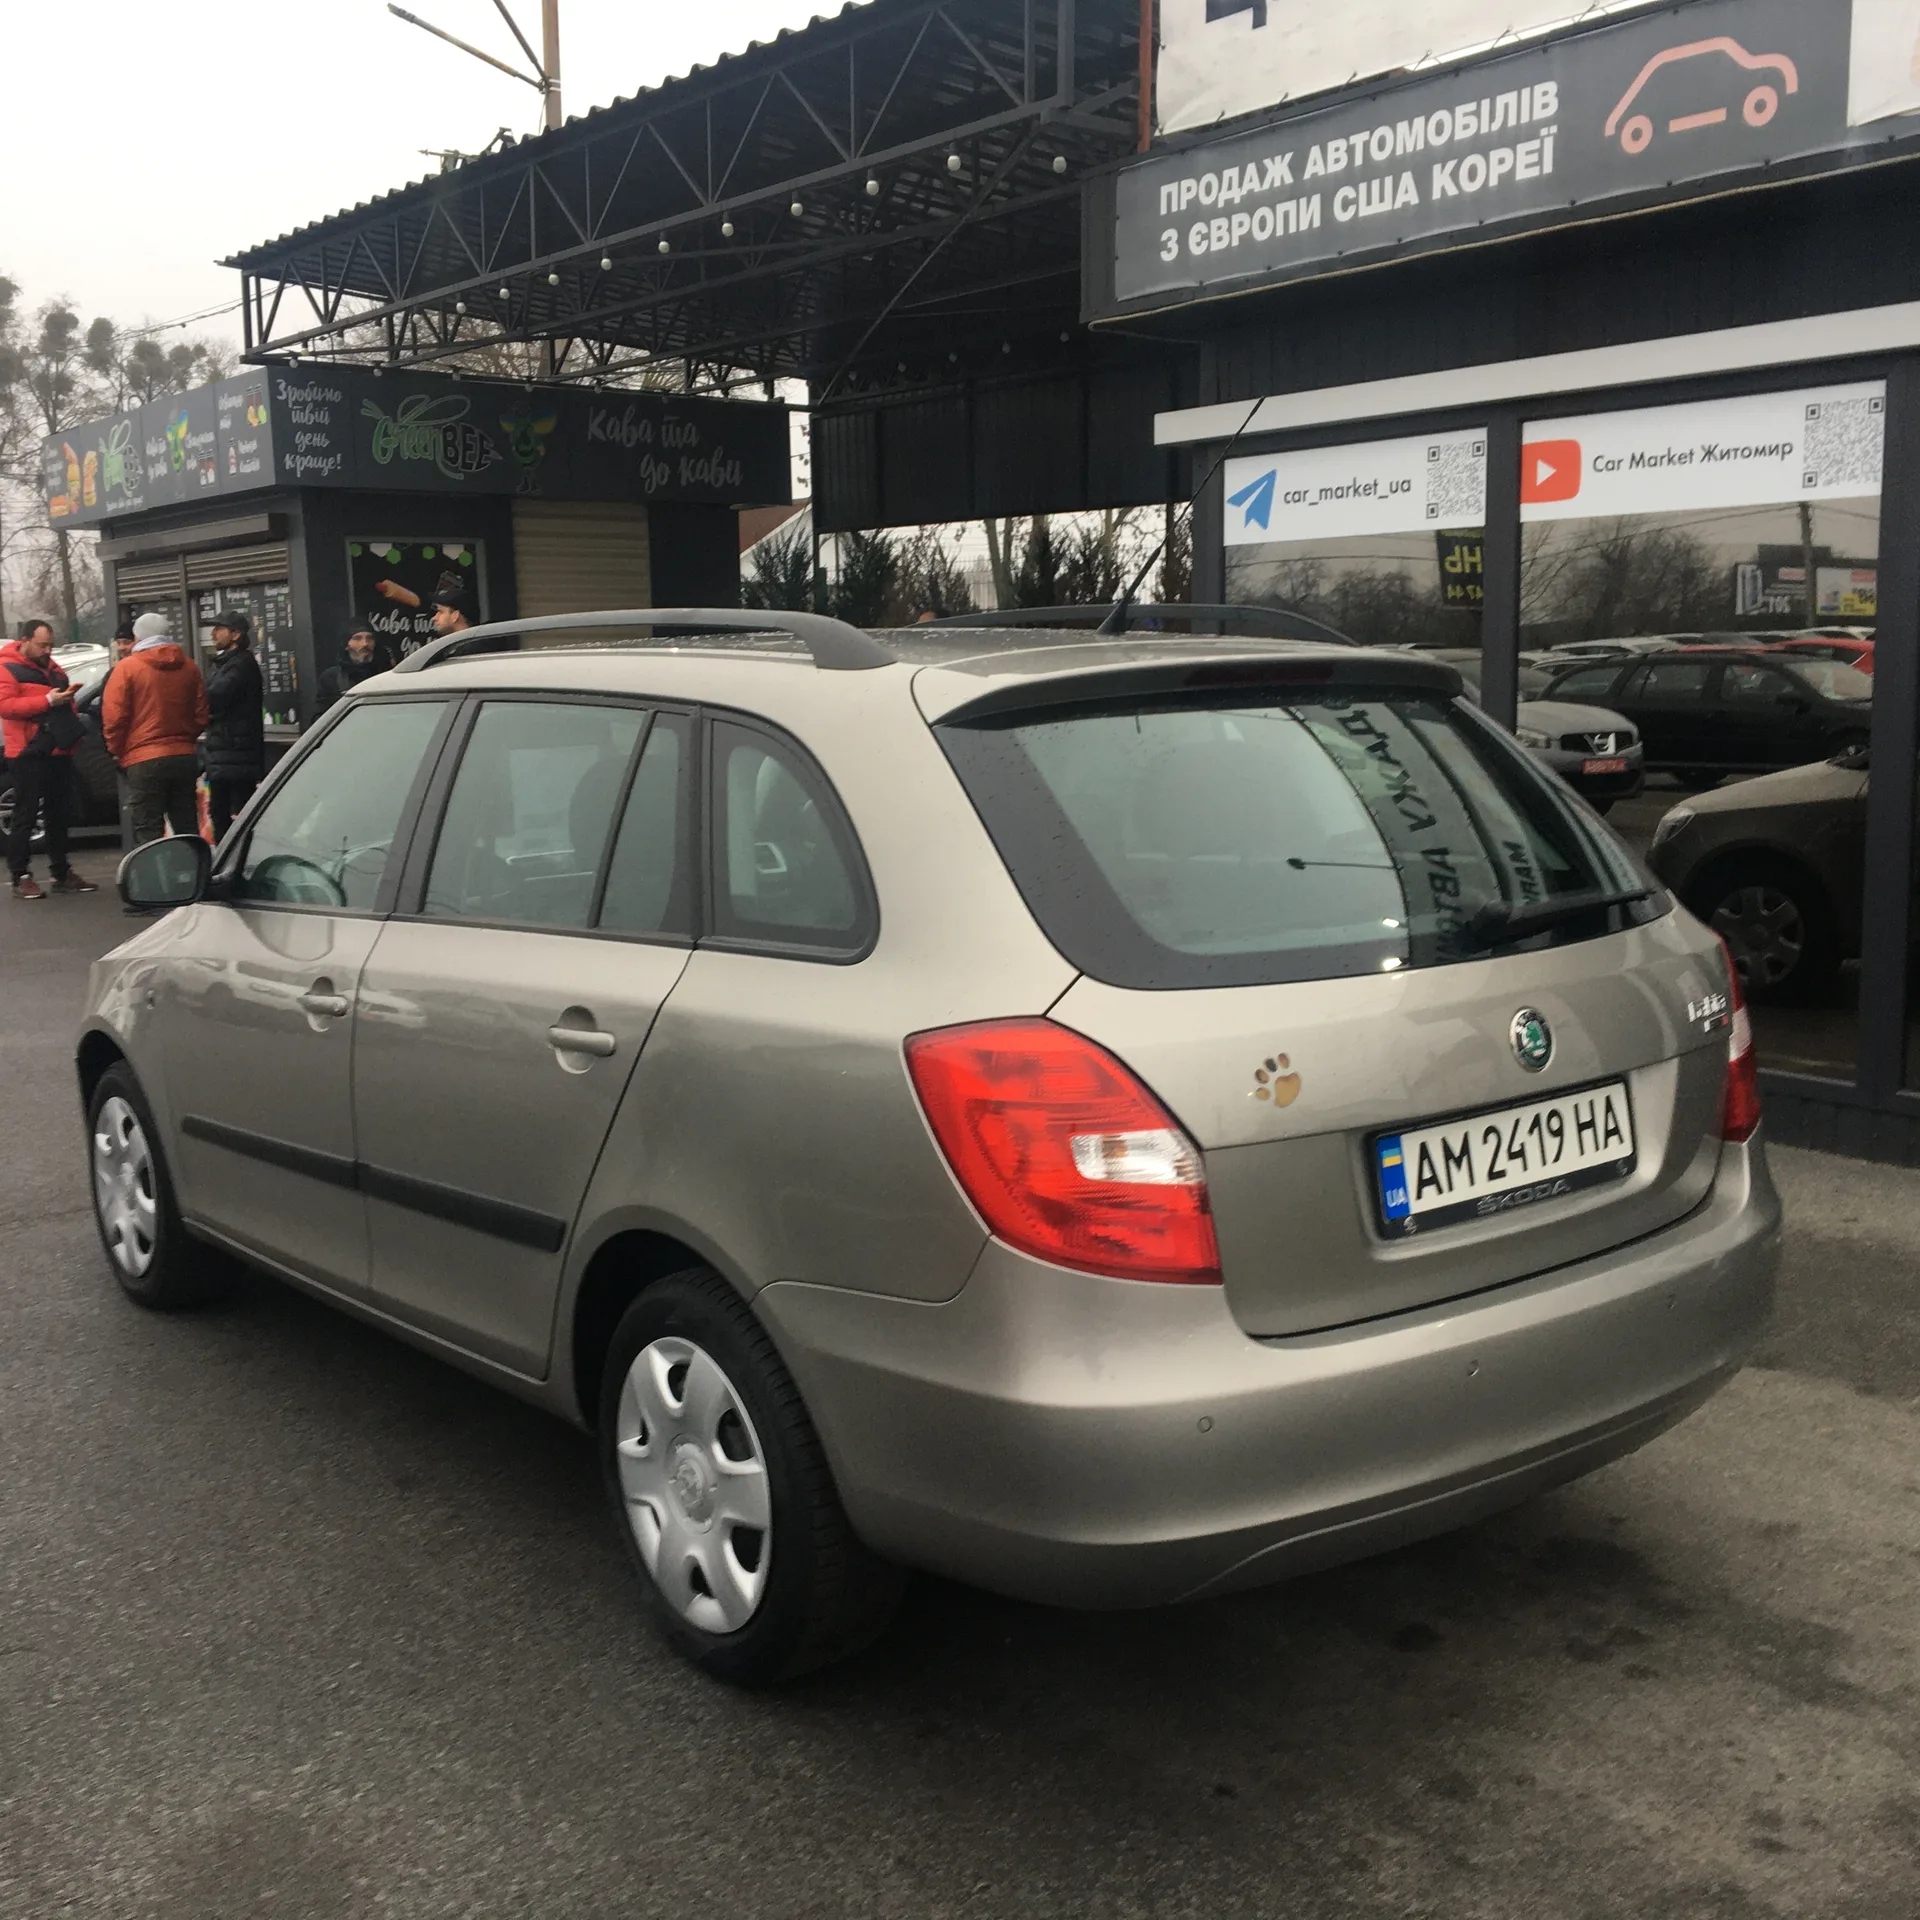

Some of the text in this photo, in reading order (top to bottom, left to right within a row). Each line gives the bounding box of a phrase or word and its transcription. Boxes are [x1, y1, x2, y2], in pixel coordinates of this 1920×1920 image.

[1160, 81, 1559, 216] ПРОДАЖ АВТОМОБІЛІВ
[1160, 125, 1558, 261] З ЄВРОПИ США КОРЕЇ
[291, 402, 330, 425] твій
[588, 405, 699, 448] Кава та
[294, 431, 330, 453] день
[1592, 441, 1794, 473] Car Market Житомир
[284, 453, 342, 478] краще!
[640, 446, 744, 494] до кави
[1283, 476, 1411, 506] car_market_ua
[368, 608, 411, 635] Кава
[1415, 1095, 1625, 1201] AM 2419 HA
[1386, 1188, 1408, 1209] UA
